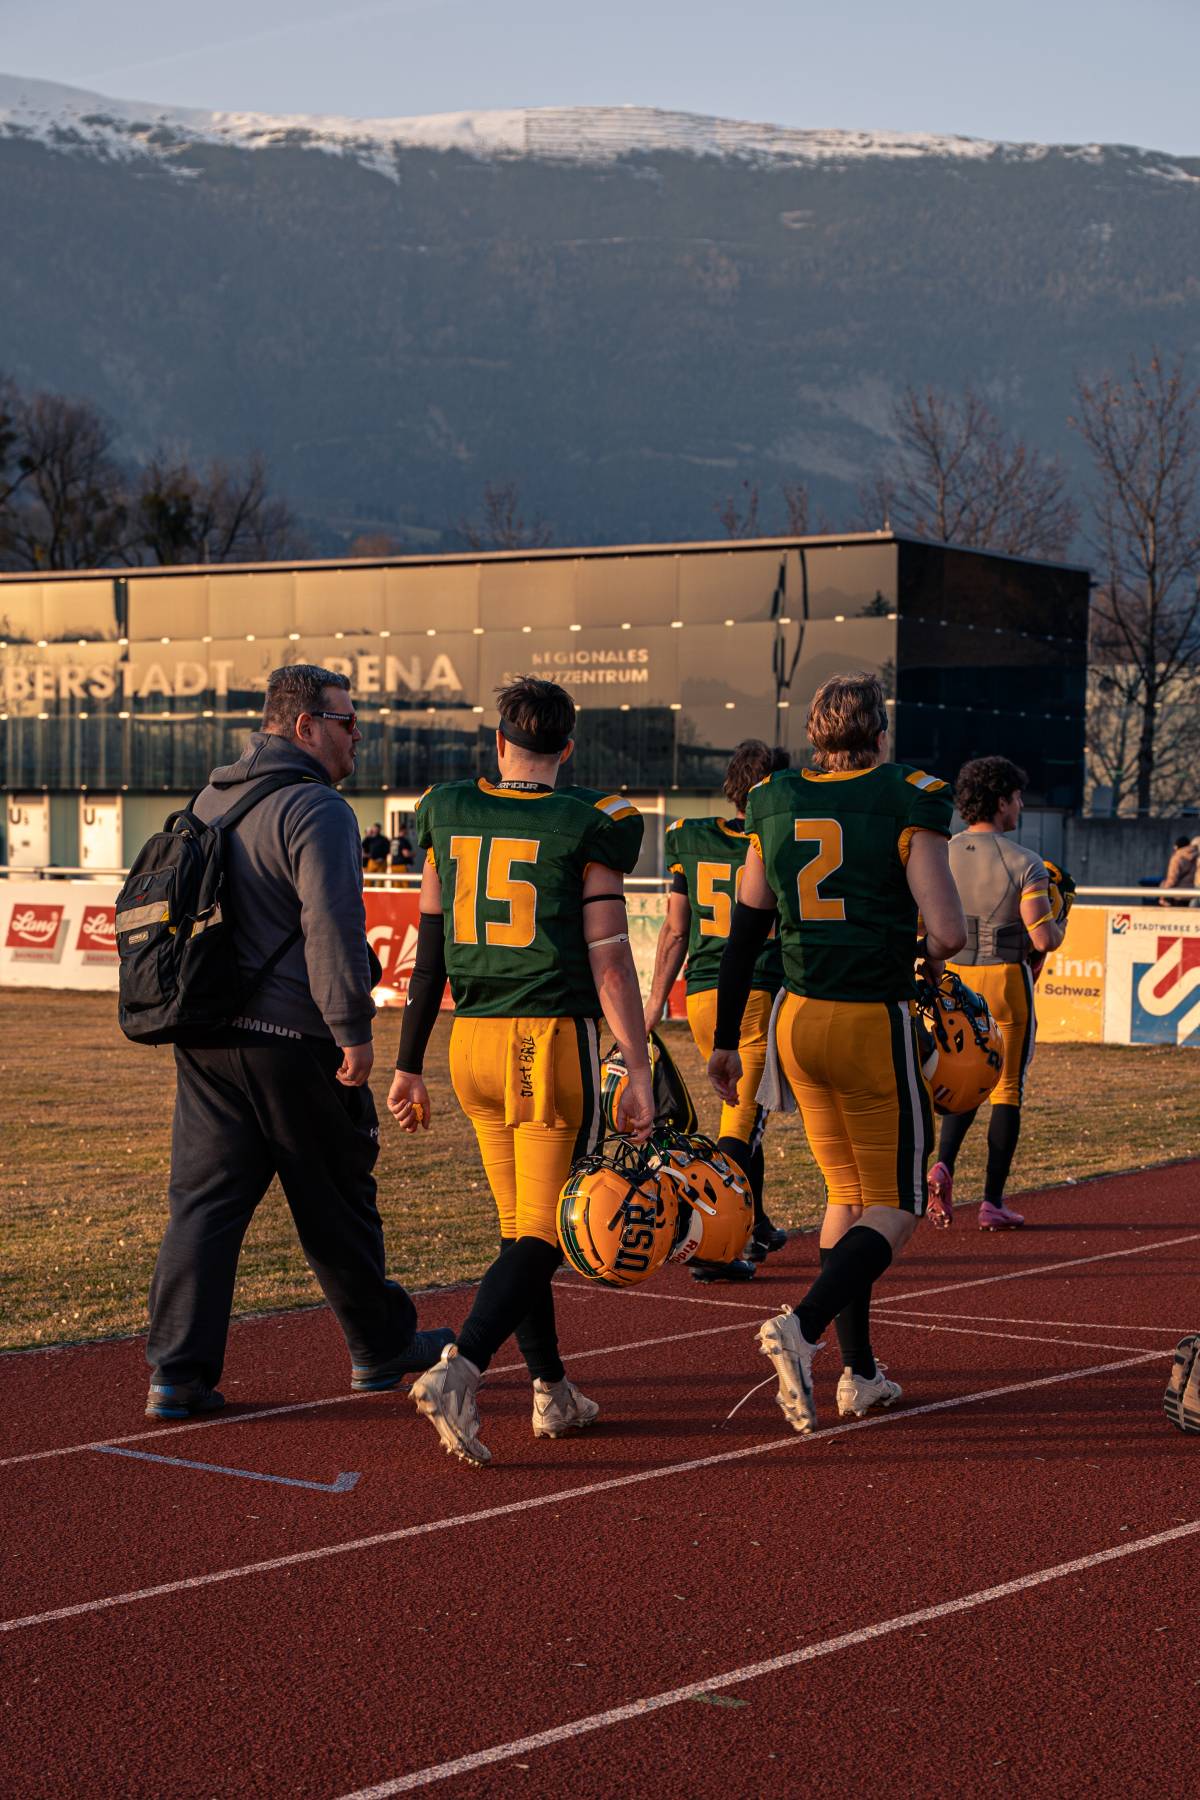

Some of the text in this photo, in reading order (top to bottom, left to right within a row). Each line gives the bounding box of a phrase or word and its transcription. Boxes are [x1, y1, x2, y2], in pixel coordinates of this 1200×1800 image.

[532, 650, 649, 665] REGIONALES
[794, 818, 846, 921] 2
[450, 835, 540, 948] 15
[696, 861, 745, 938] 5
[12, 911, 59, 942] Lang
[1133, 923, 1191, 932] STADTWERKE
[1045, 984, 1100, 997] Schwaz
